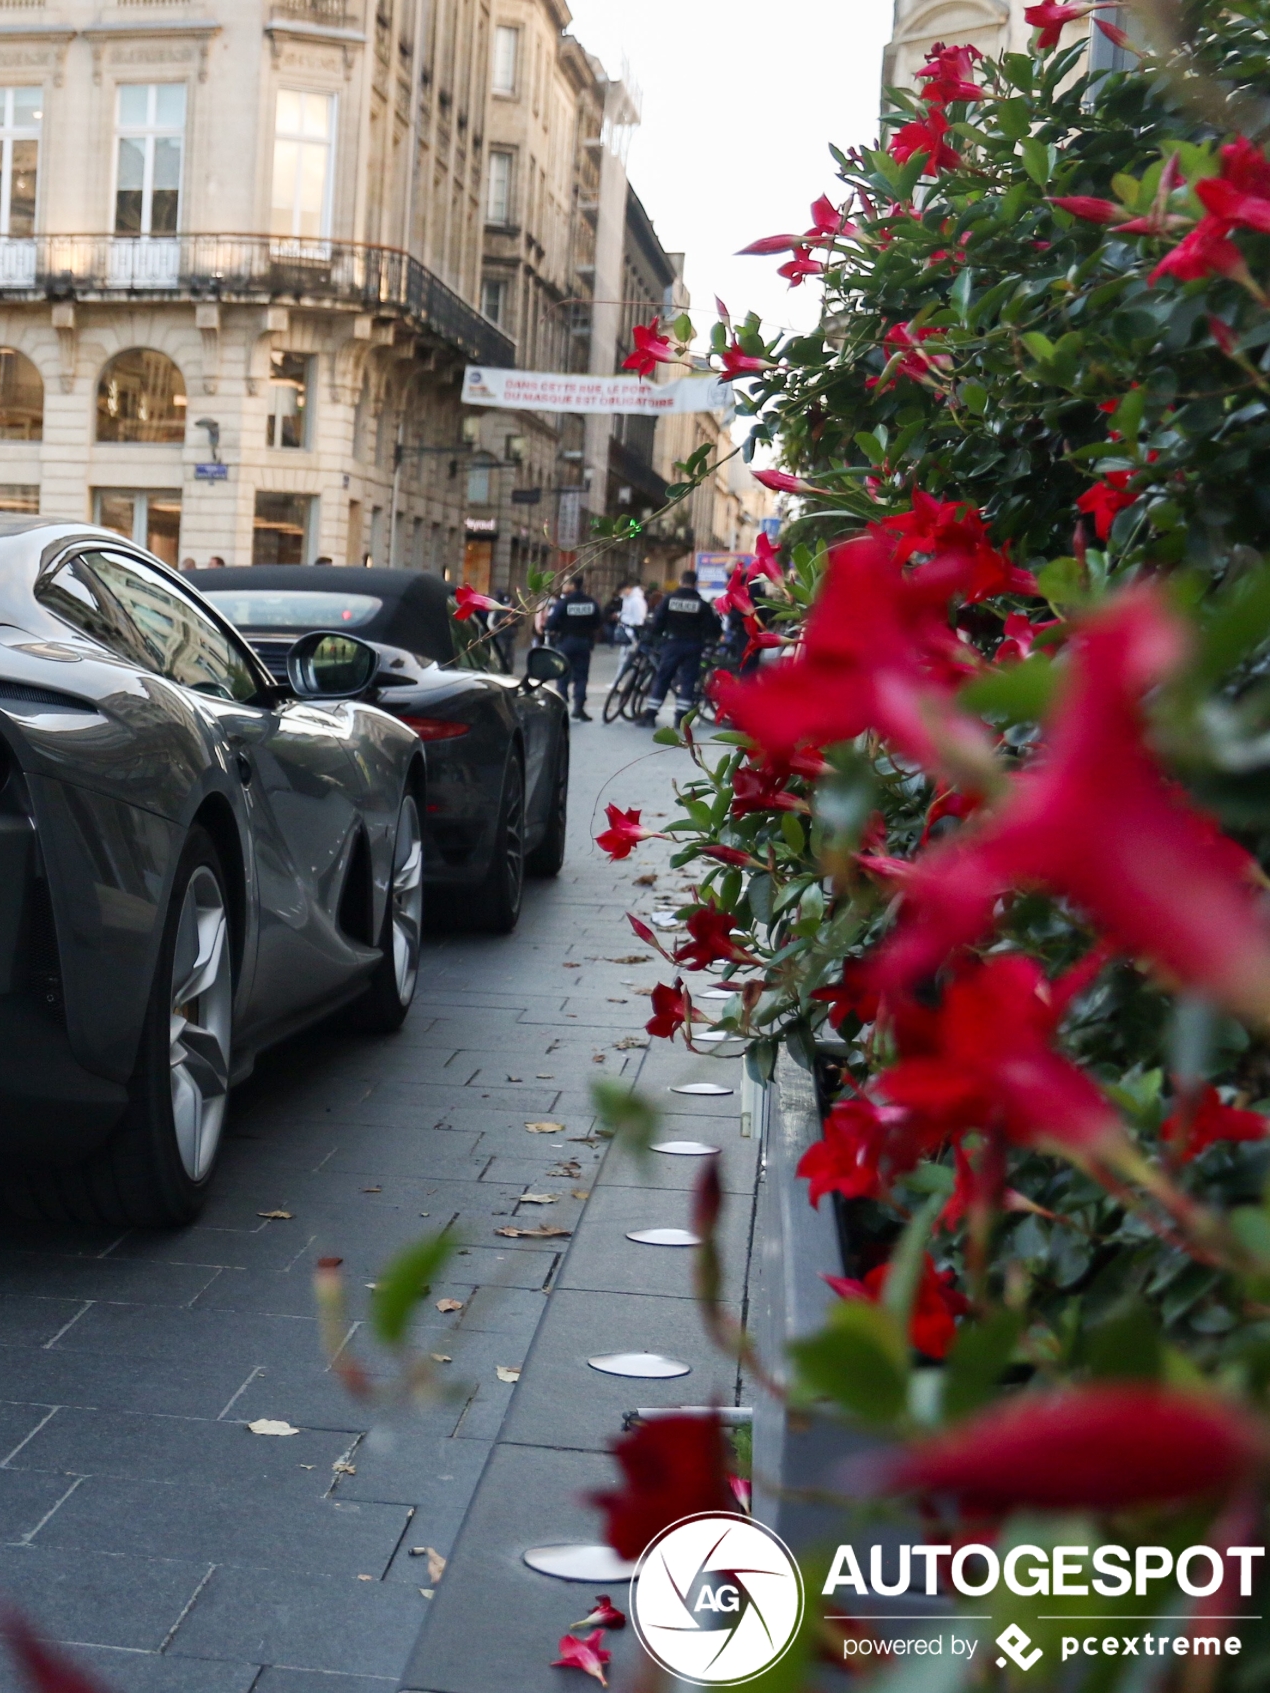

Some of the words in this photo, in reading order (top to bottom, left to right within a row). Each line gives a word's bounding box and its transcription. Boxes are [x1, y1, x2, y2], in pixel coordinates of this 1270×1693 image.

[505, 378, 538, 390] DANS
[540, 380, 576, 392] CETTE
[607, 384, 620, 394] LE
[621, 384, 652, 395] PORT
[504, 391, 520, 401] DU
[522, 392, 571, 405] MASQUE
[575, 394, 597, 405] EST
[599, 396, 675, 409] OBLIGATOIRE
[670, 601, 697, 611] POLICE
